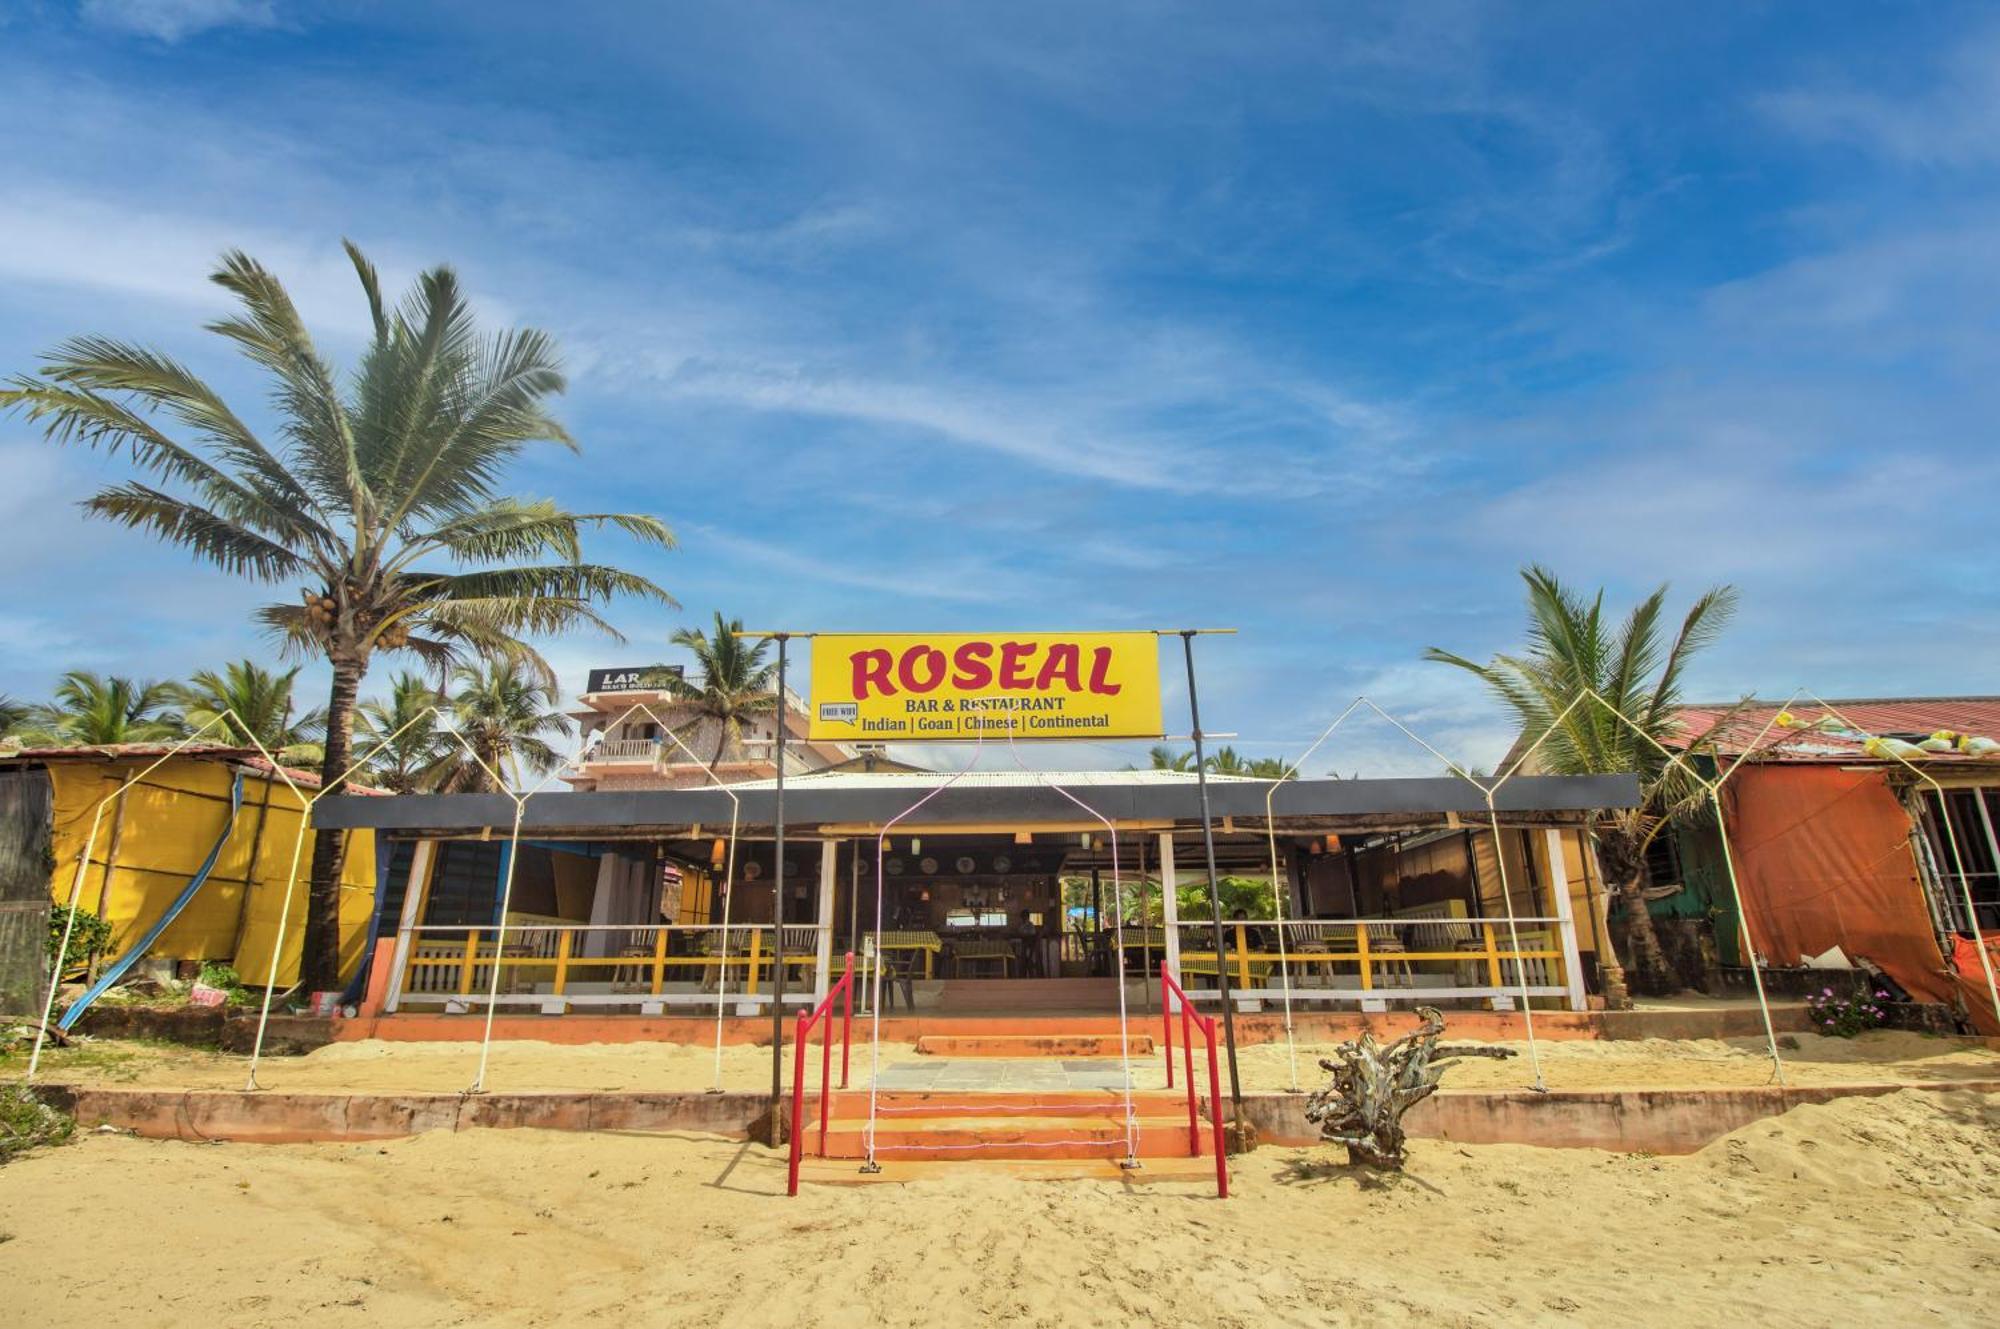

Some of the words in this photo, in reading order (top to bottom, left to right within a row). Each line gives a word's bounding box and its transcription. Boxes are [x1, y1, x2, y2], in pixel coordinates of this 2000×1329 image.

[849, 641, 1121, 700] ROSEAL
[905, 700, 938, 713] BAR
[942, 700, 955, 713] &
[959, 697, 1065, 712] RESTAURANT
[861, 718, 906, 731] Indian
[918, 717, 953, 730] Goan
[964, 715, 1019, 730] Chinese
[1029, 714, 1110, 728] Continental
